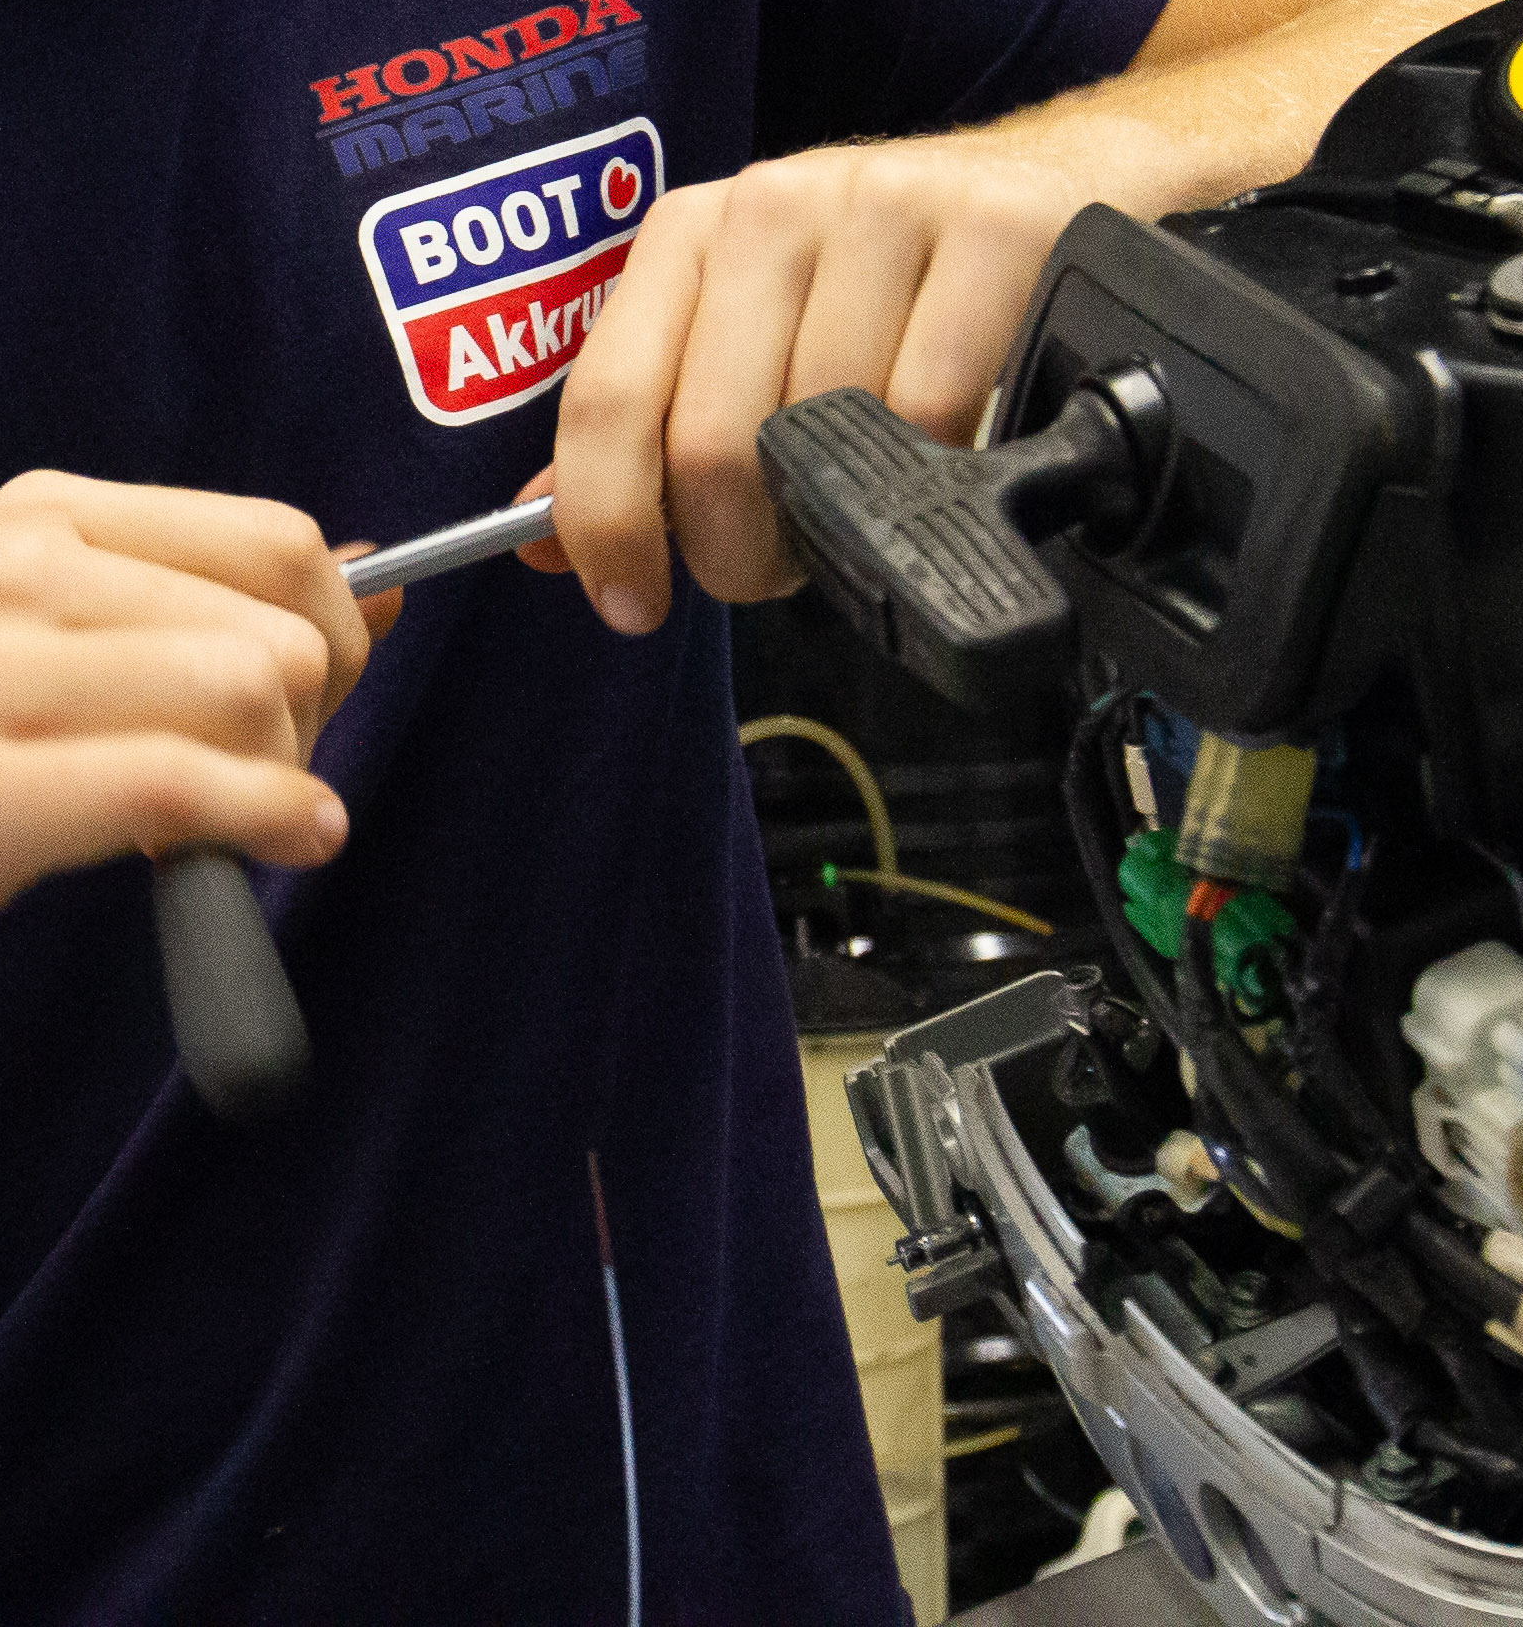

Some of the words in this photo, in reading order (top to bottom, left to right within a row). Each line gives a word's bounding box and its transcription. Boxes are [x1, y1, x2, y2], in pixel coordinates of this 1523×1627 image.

[330, 37, 648, 178] MARINE
[399, 174, 583, 286] BOOT
[447, 274, 624, 392] Akkru
